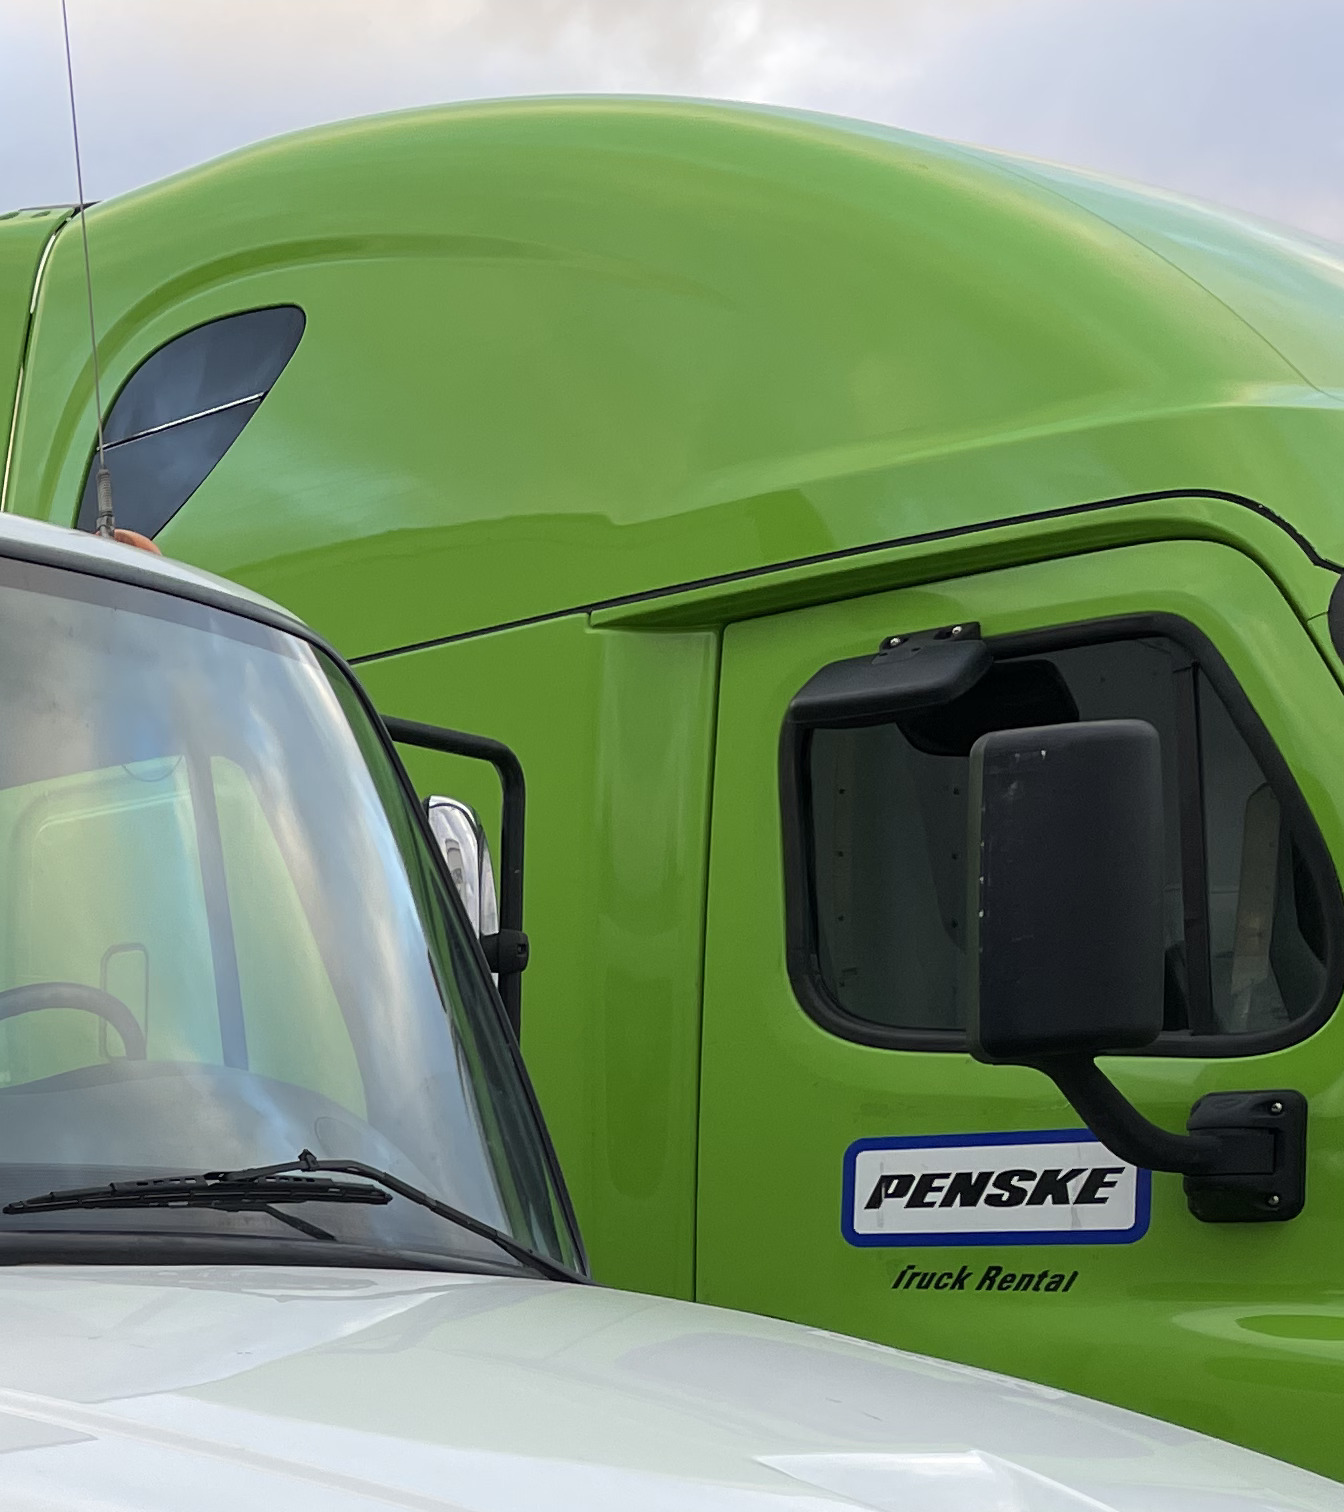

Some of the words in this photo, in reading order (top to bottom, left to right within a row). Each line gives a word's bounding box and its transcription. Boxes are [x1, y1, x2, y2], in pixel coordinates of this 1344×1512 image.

[864, 1166, 1126, 1210] PENSKE
[891, 1264, 973, 1291] Truck
[975, 1265, 1079, 1293] Rental
